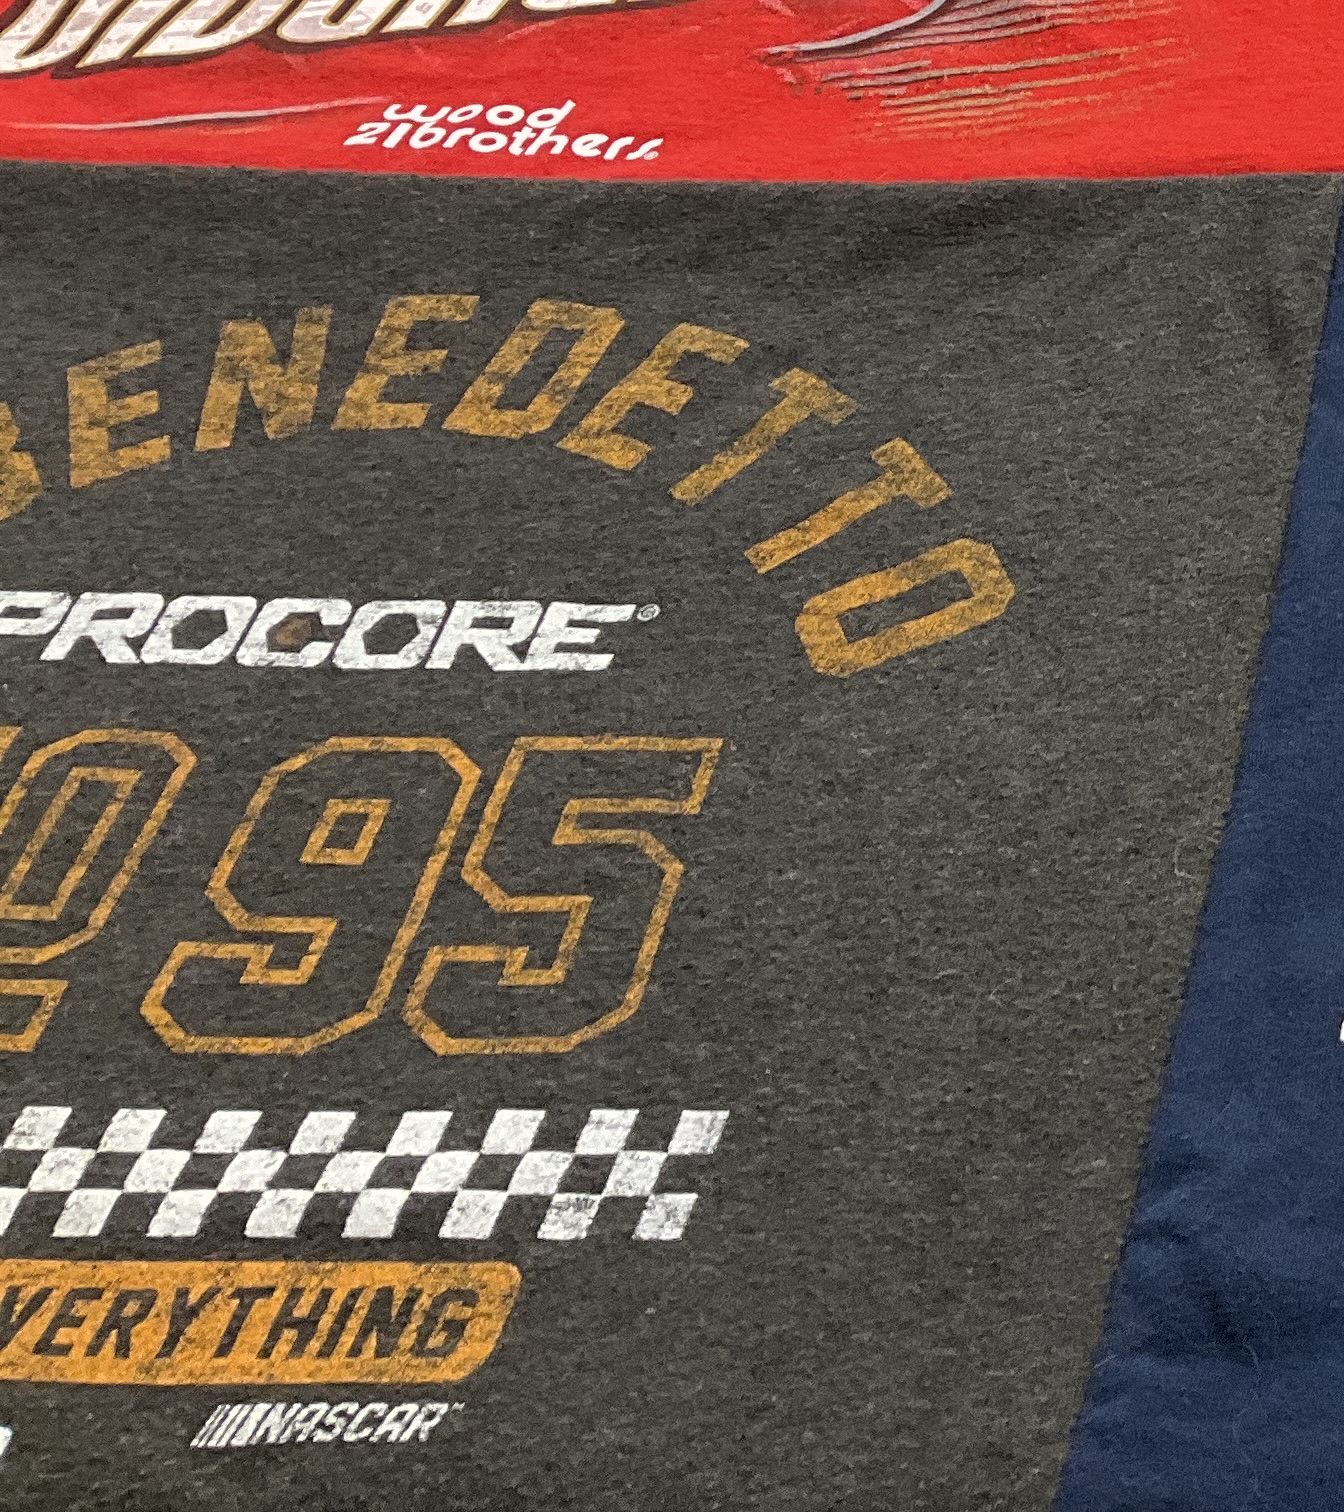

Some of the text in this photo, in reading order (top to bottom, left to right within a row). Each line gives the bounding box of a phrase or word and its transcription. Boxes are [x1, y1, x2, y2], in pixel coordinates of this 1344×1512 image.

[382, 98, 577, 129] wood
[0, 590, 640, 672] PROCORE
[191, 1400, 464, 1449] NASCAR
